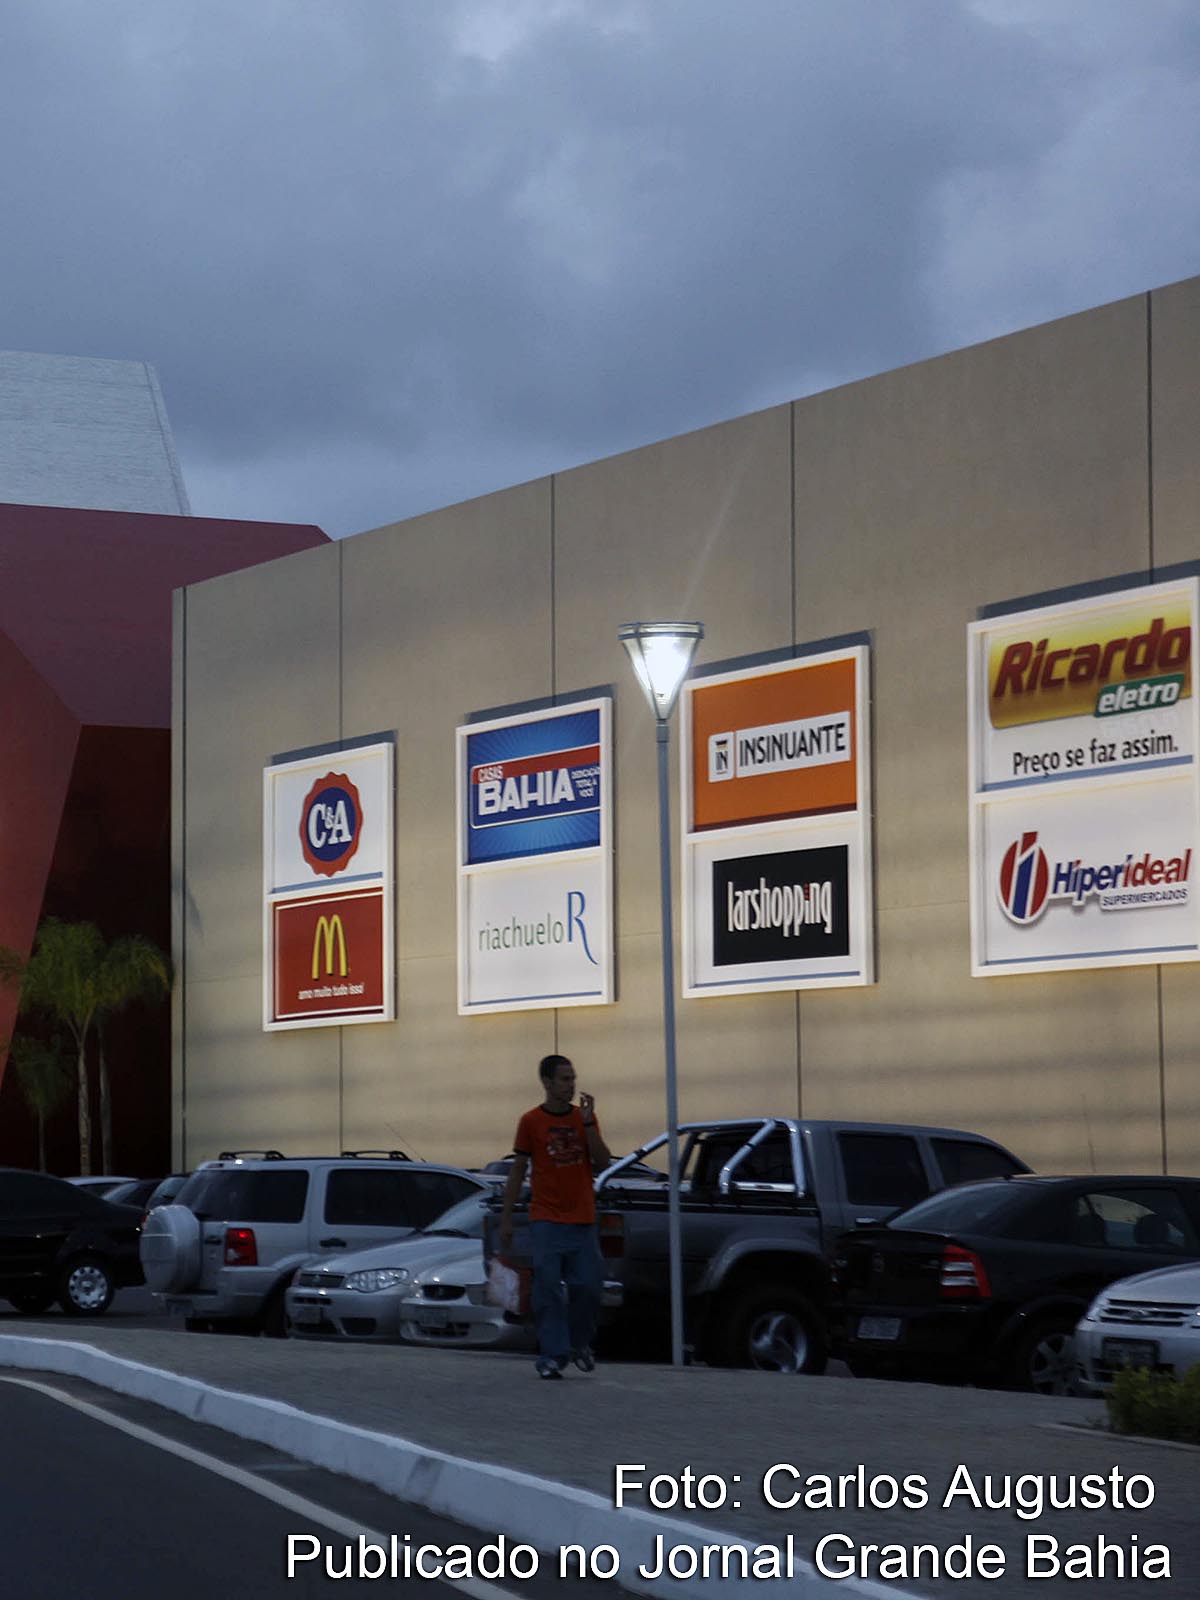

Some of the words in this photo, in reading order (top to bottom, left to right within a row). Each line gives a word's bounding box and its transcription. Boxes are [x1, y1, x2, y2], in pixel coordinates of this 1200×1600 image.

[993, 617, 1191, 698] Ricardo
[1098, 682, 1180, 713] eletro
[739, 722, 846, 767] INSINUANTE
[1013, 750, 1061, 779] Preço
[1065, 747, 1085, 768] se
[1090, 738, 1117, 764] faz
[1122, 729, 1179, 759] assim.
[478, 767, 576, 816] BAHIA
[308, 800, 352, 848] C&A
[1052, 849, 1191, 901] Hiperideal
[479, 912, 564, 951] riachuelo
[727, 877, 832, 937] larshopping
